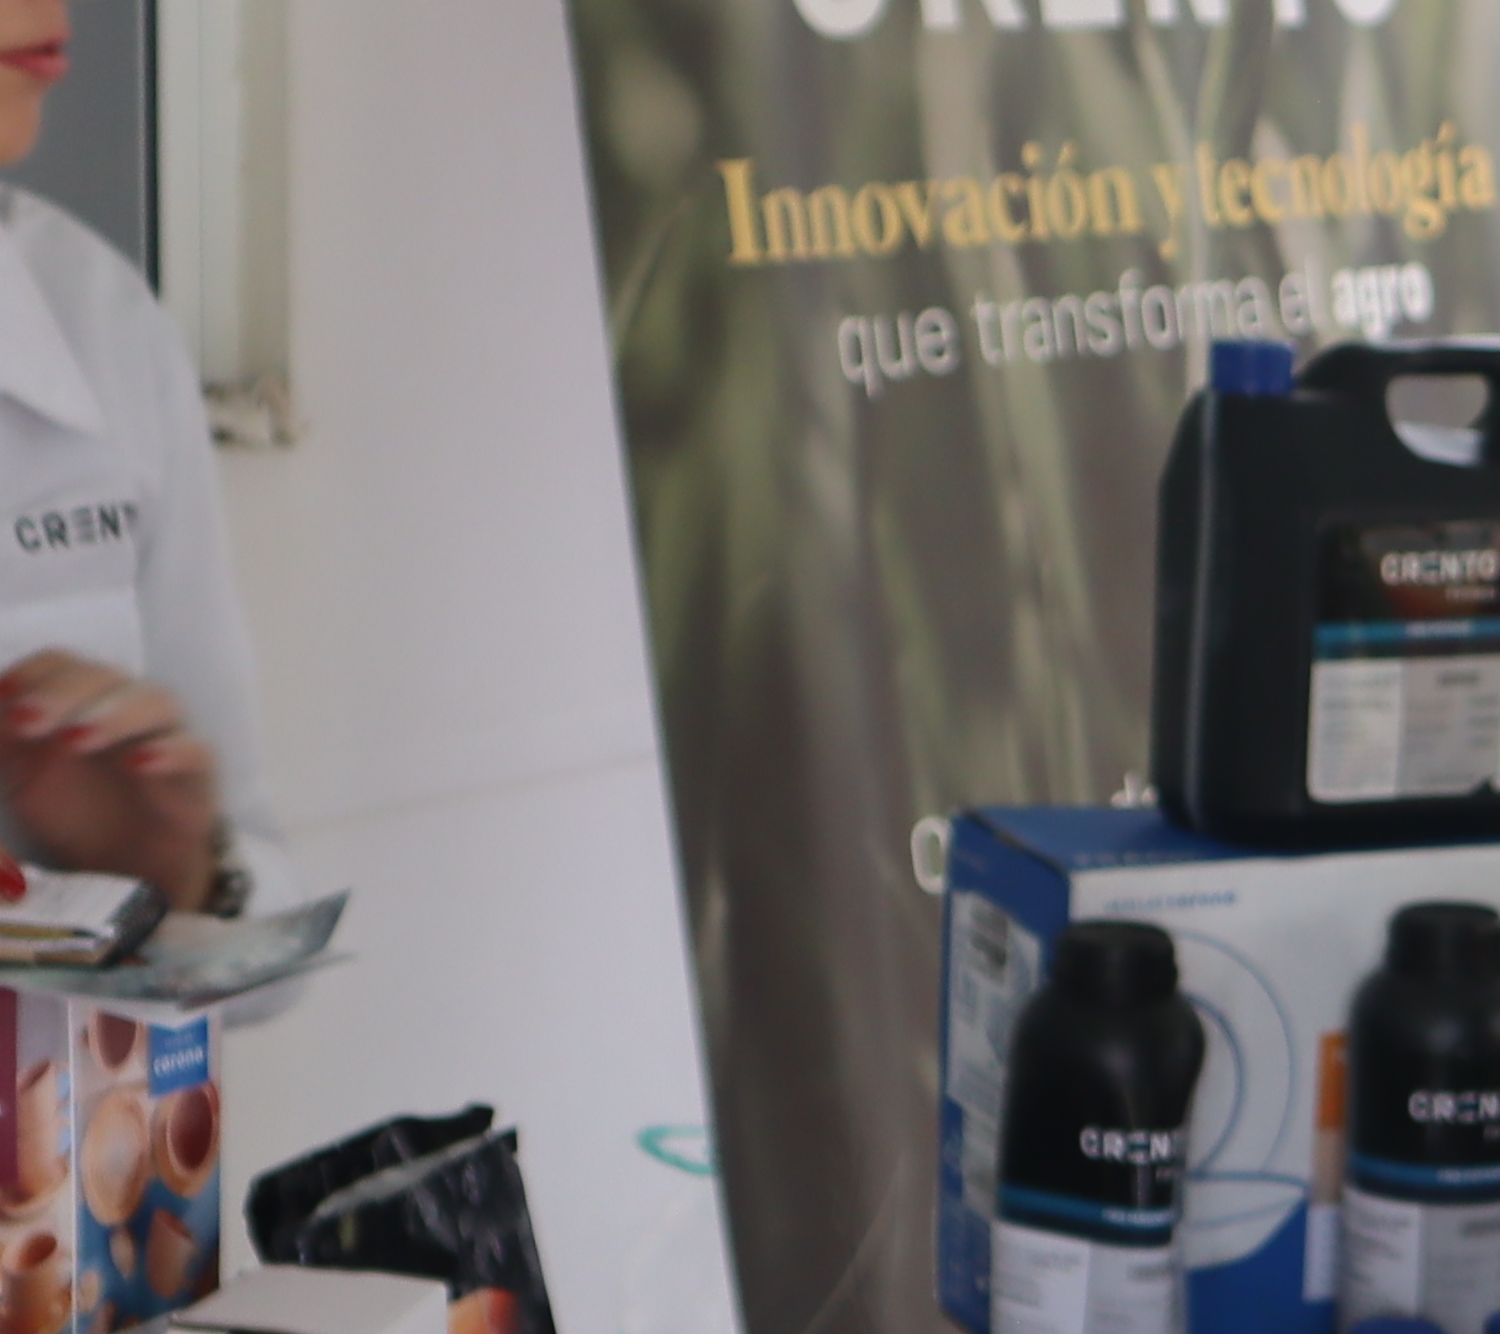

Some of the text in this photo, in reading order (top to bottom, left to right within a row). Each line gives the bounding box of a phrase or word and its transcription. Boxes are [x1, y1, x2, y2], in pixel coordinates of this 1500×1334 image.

[715, 121, 1496, 265] Innovación y tecnología
[836, 303, 960, 396] que
[971, 268, 1267, 368] transforma
[1331, 261, 1434, 338] agro
